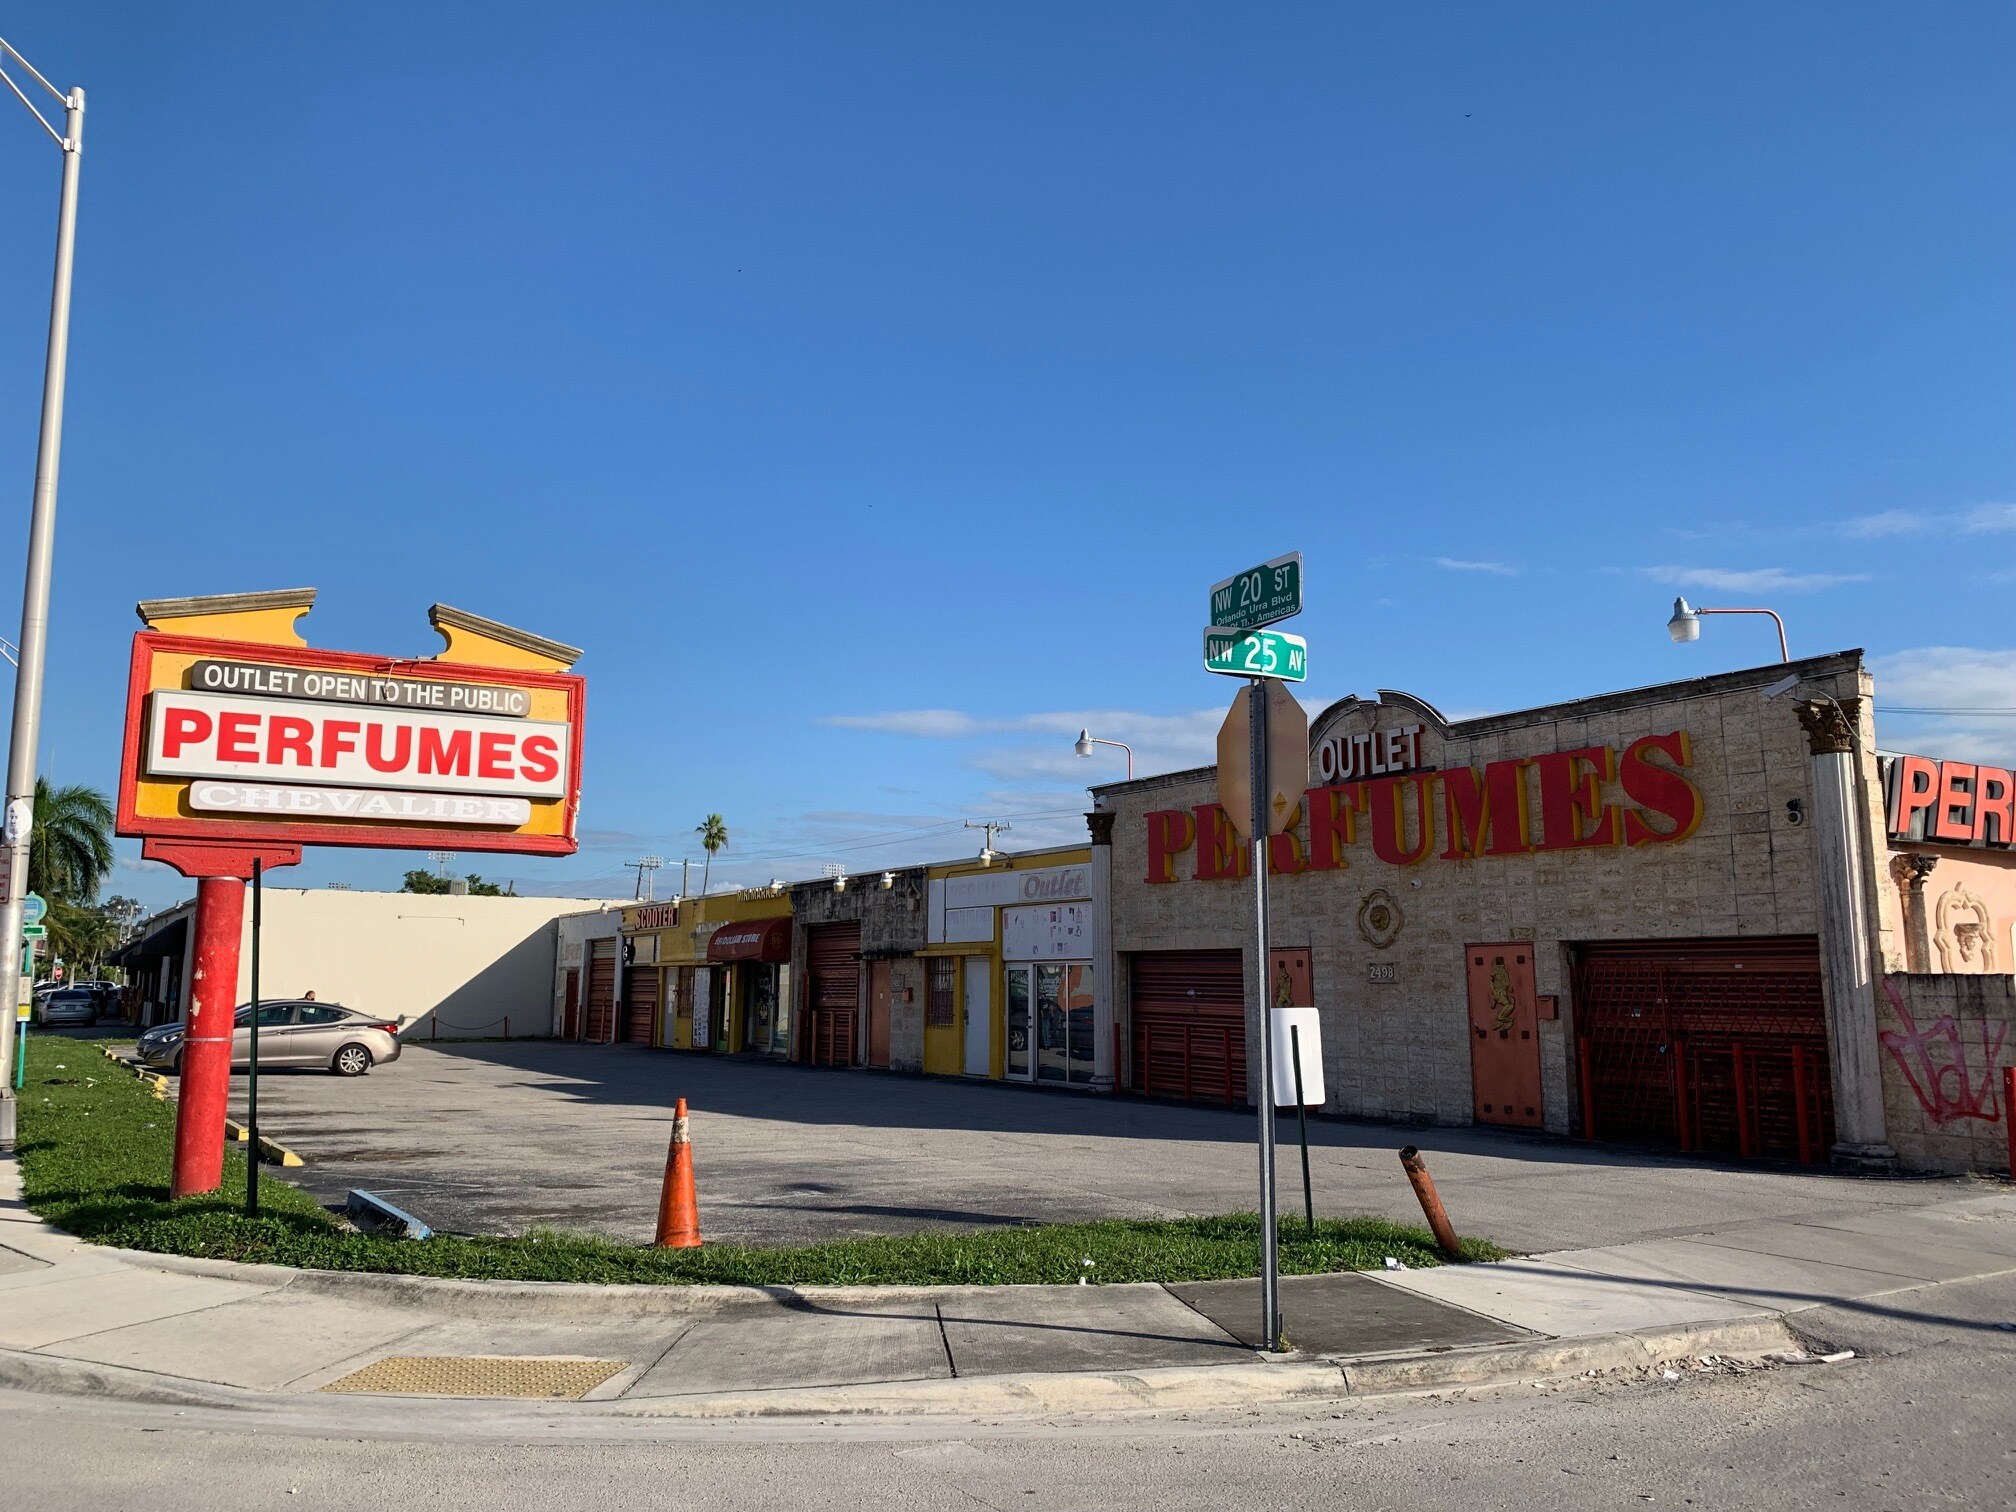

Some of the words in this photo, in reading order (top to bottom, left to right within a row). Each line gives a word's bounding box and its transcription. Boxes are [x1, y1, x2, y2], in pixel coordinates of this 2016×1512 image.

[1215, 587, 1232, 613] NW
[1240, 572, 1262, 607] 20
[1274, 565, 1290, 592] ST
[1217, 609, 1246, 626] Orlando
[1249, 600, 1268, 614] Urra
[1271, 592, 1293, 607] Blvd
[1257, 604, 1296, 622] Americas
[1209, 640, 1233, 663] NW
[1244, 636, 1278, 672] 25
[1288, 649, 1303, 672] AV
[203, 664, 298, 694] OUTLET
[303, 673, 366, 700] OPEN
[371, 680, 400, 702] TO
[403, 683, 445, 706] THE
[450, 687, 524, 713] PUBLIC
[162, 707, 560, 783] PERFUMES
[1319, 724, 1425, 781] OUTLET
[199, 785, 524, 822] CHEVALIER
[1890, 756, 2016, 844] PER
[1024, 870, 1083, 898] Outlet
[634, 906, 674, 930] SCOOTER
[1370, 966, 1394, 978] 2498
